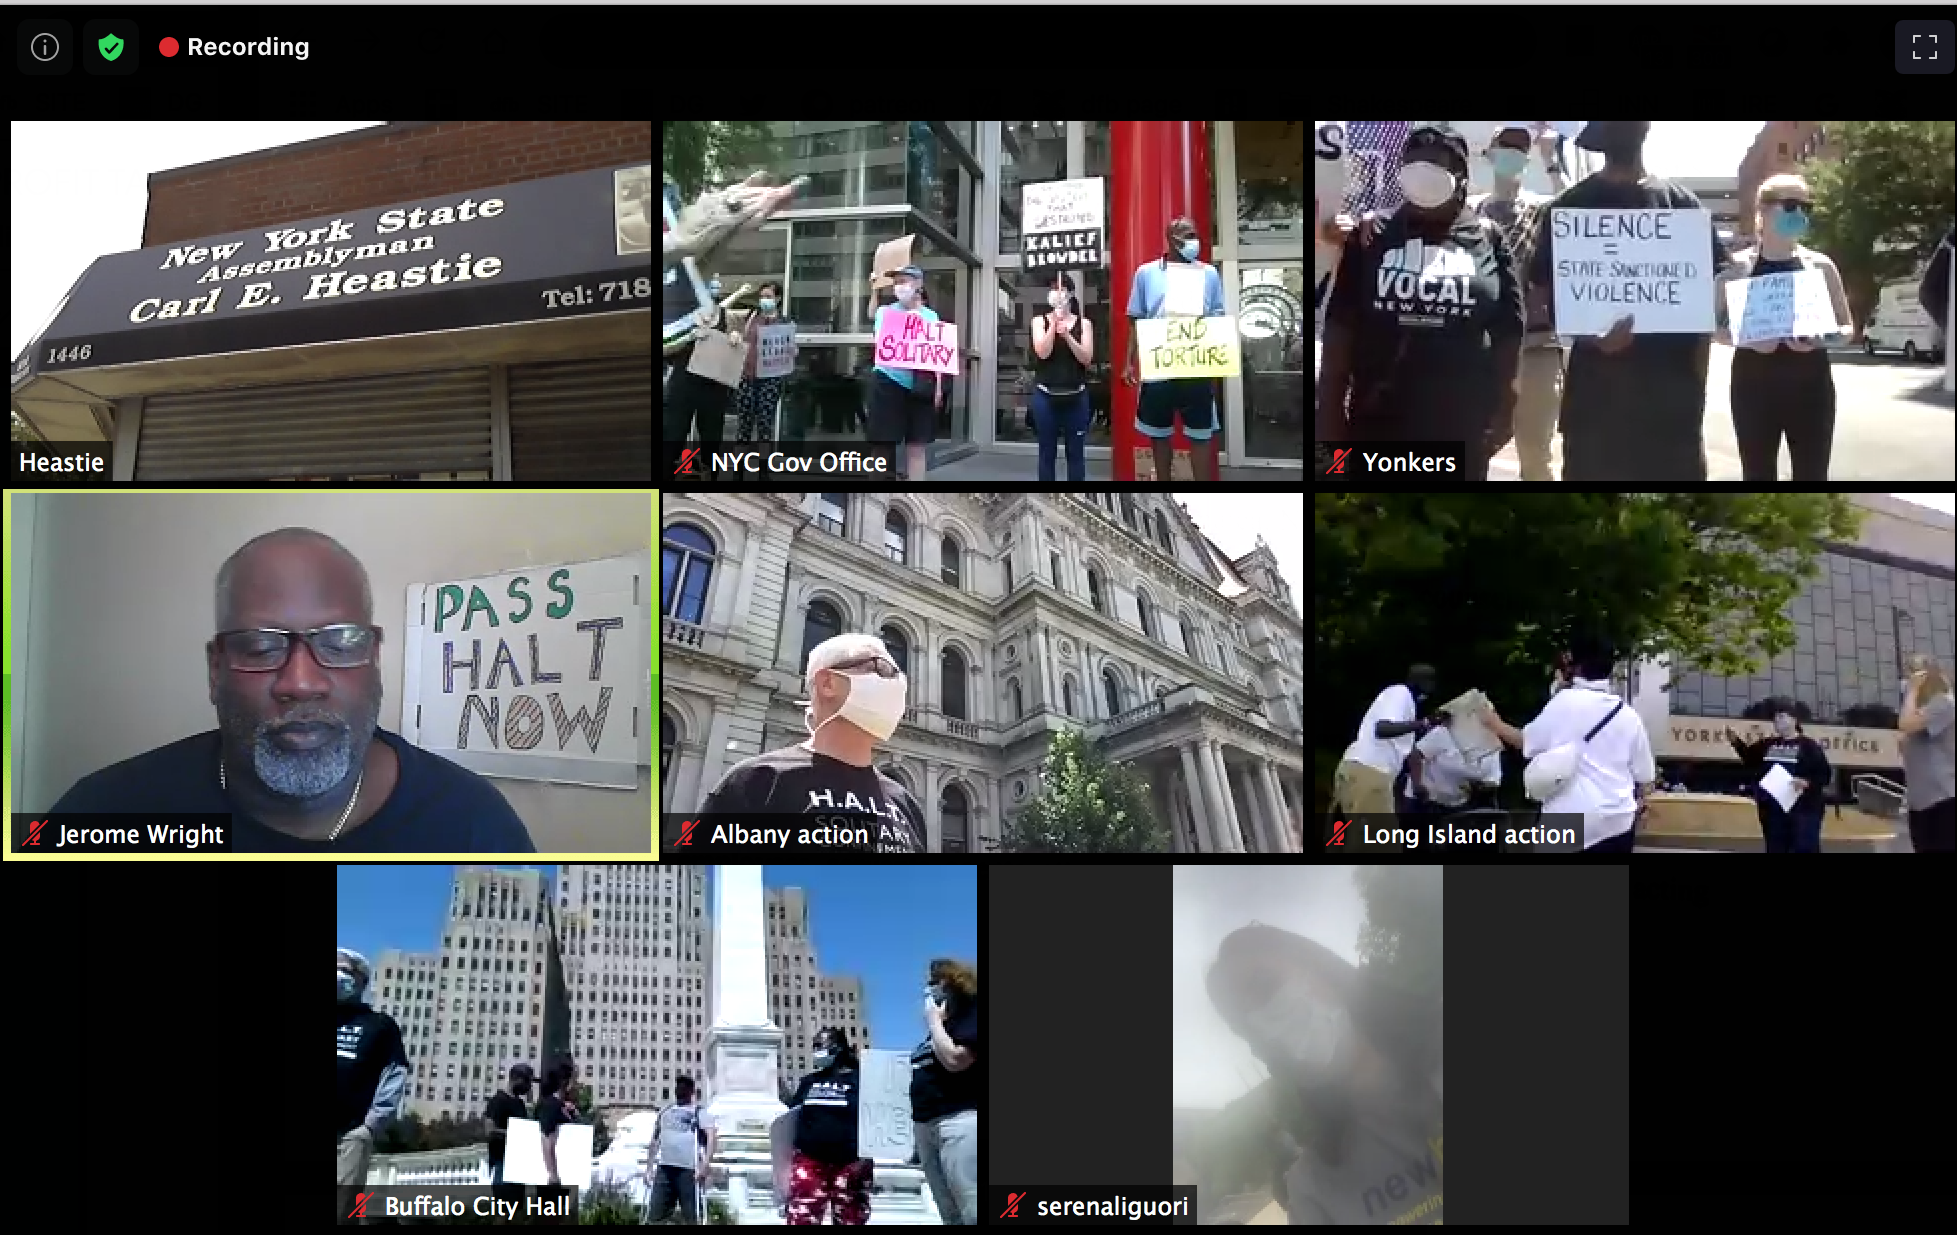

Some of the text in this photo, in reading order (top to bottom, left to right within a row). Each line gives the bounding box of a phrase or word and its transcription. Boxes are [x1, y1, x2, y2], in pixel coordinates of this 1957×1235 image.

[159, 198, 505, 270] New York State
[1554, 210, 1673, 240] SILENCE
[196, 234, 435, 284] Assemblyman
[1557, 259, 1698, 279] STATE SANCTIONED
[129, 252, 503, 324] Carl E. Heastie
[540, 276, 651, 309] Tel: 718
[1377, 268, 1477, 305] VOCAL
[1570, 279, 1683, 306] VIOLENCE
[903, 313, 946, 341] HALT
[1166, 316, 1209, 342] END
[46, 344, 93, 364] 1446
[878, 334, 956, 368] SOLITARY
[1149, 343, 1230, 369] TORTURE
[434, 569, 574, 633] PASS
[442, 616, 624, 693] HALT
[456, 686, 614, 753] NOW
